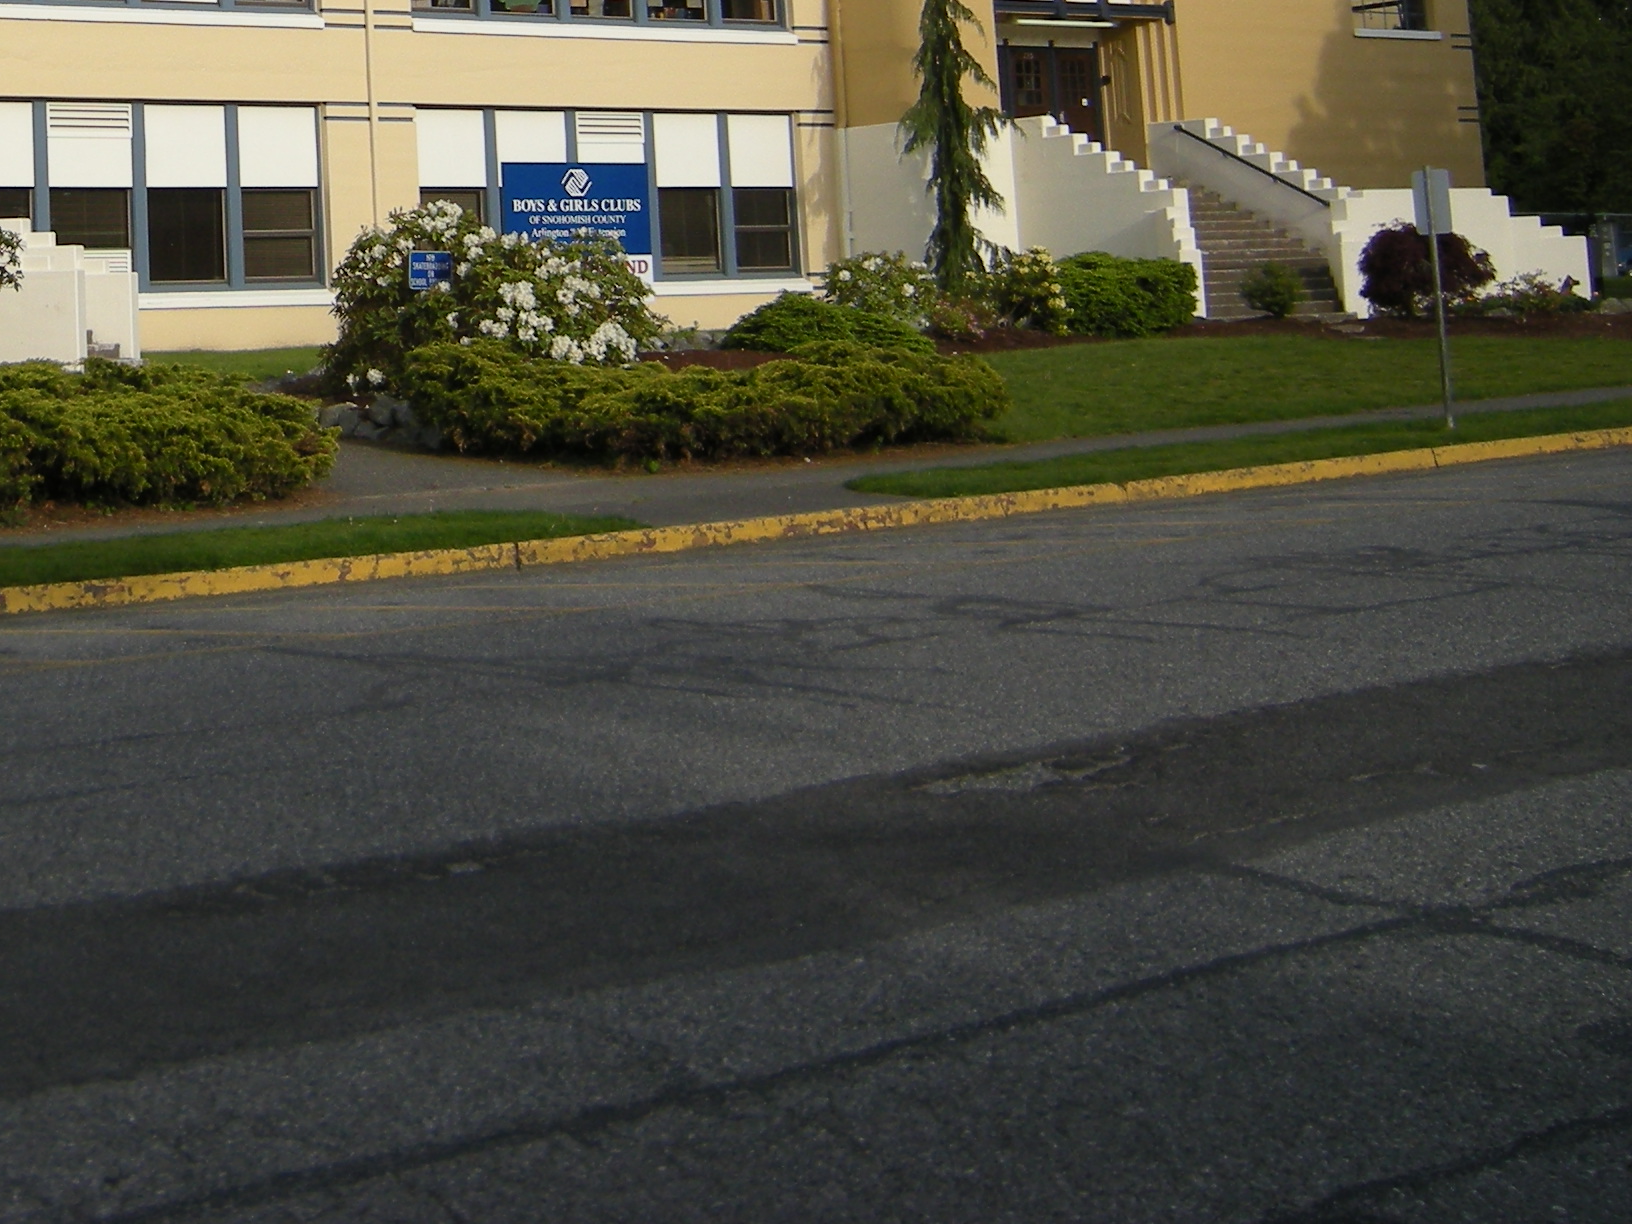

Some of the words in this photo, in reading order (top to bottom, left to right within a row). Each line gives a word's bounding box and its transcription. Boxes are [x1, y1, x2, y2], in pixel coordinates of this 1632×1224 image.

[513, 198, 545, 212] BOYS
[547, 199, 558, 212] &
[559, 198, 599, 212] GIRLS
[600, 198, 641, 212] CLUBS
[529, 215, 540, 225] OF
[541, 215, 591, 225] SNOHOMISH
[592, 214, 627, 224] COUNTY
[531, 227, 569, 239] Arlington
[587, 227, 627, 238] Etension
